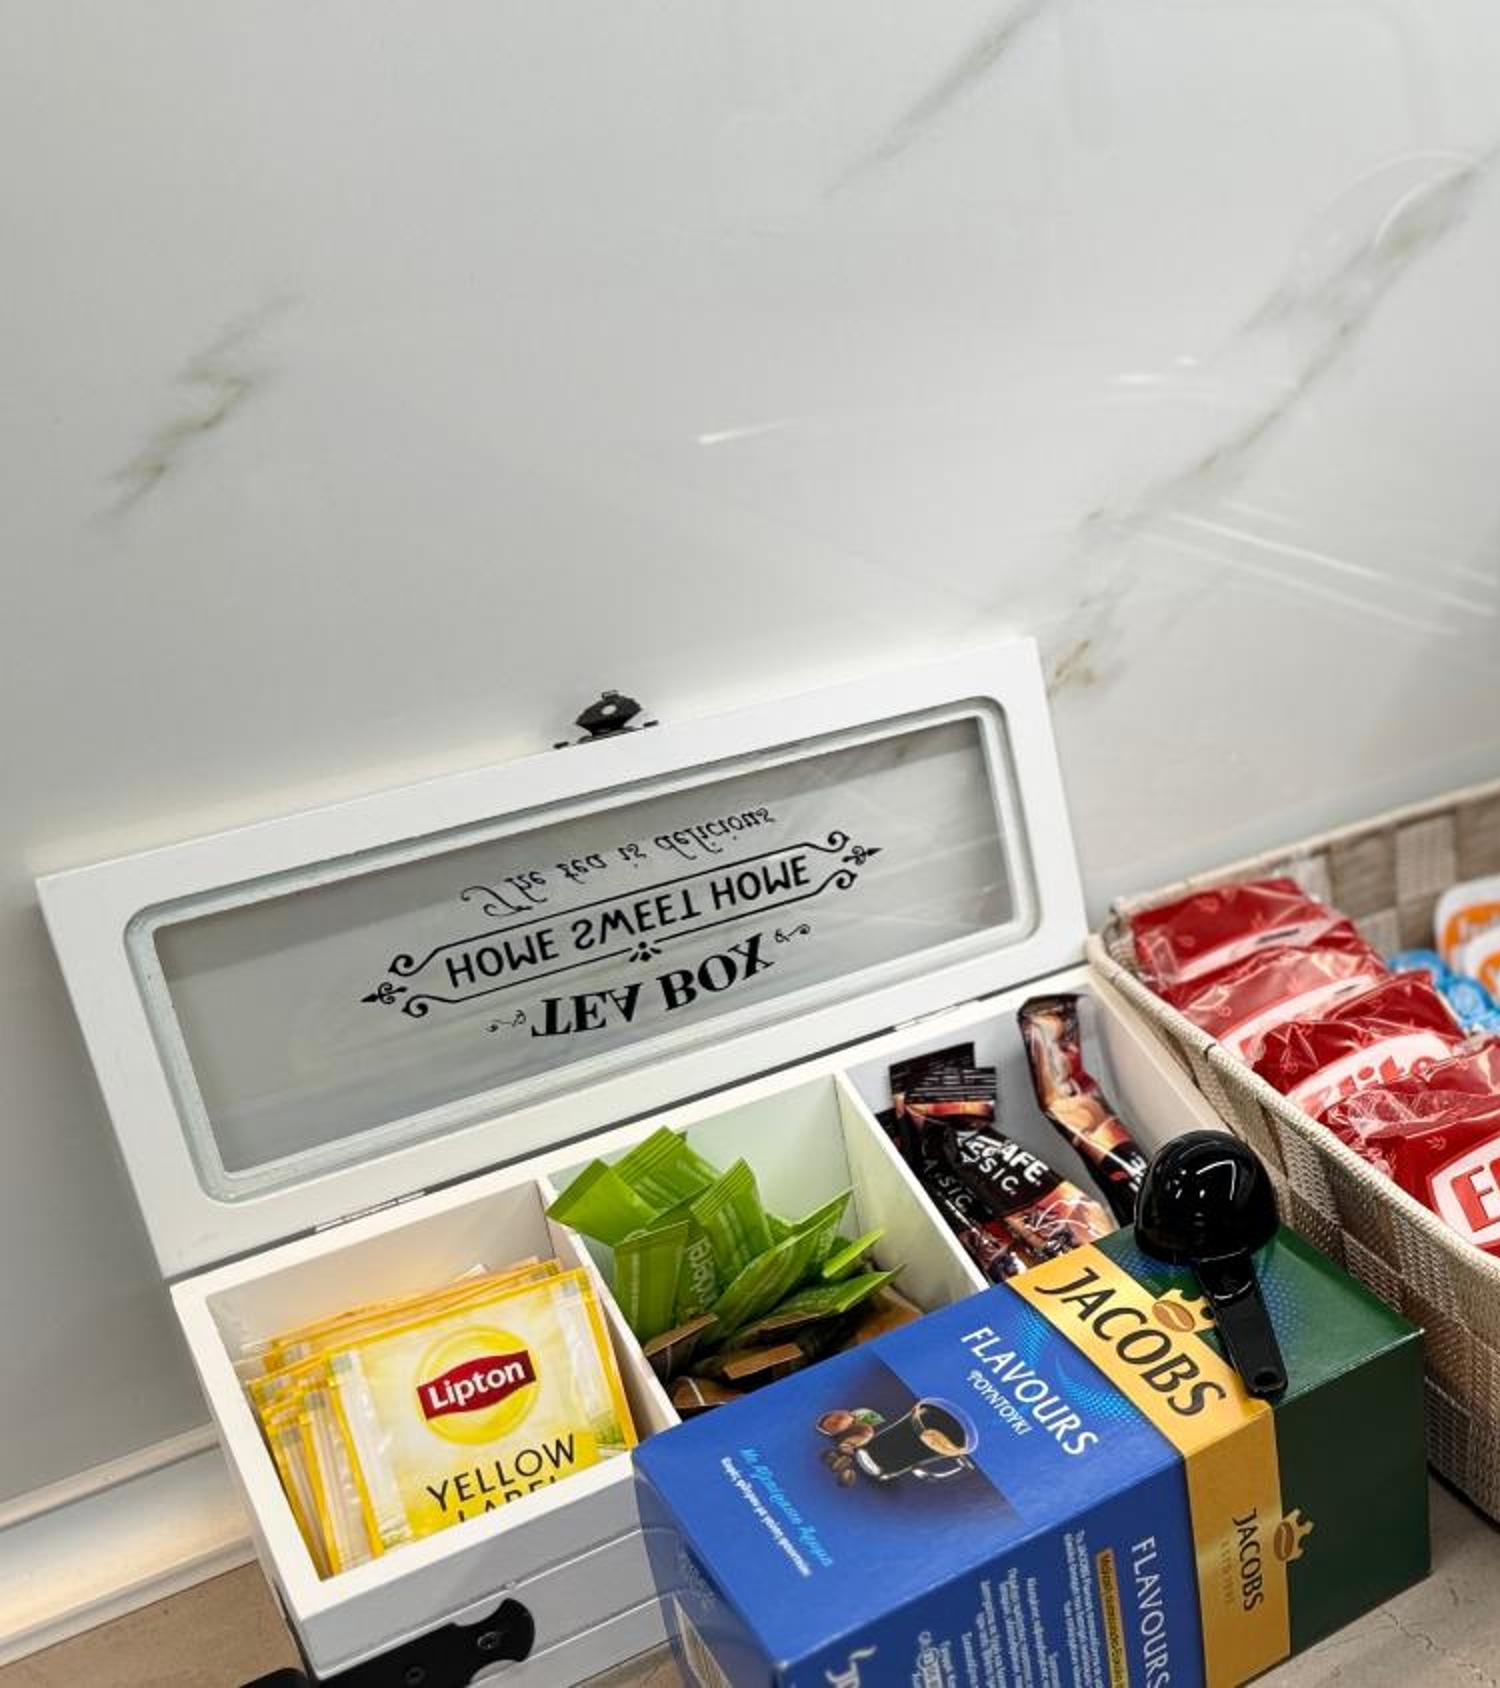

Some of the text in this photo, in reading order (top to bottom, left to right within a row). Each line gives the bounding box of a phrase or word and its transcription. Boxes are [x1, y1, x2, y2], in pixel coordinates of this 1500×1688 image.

[427, 1361, 526, 1410] Lipton
[960, 1325, 1099, 1455] FLAVOURS
[1034, 1267, 1227, 1417] JACOBS
[426, 1432, 576, 1512] YELLOW
[1131, 1535, 1172, 1688] FLAVOURS
[1231, 1507, 1265, 1612] JACOBS
